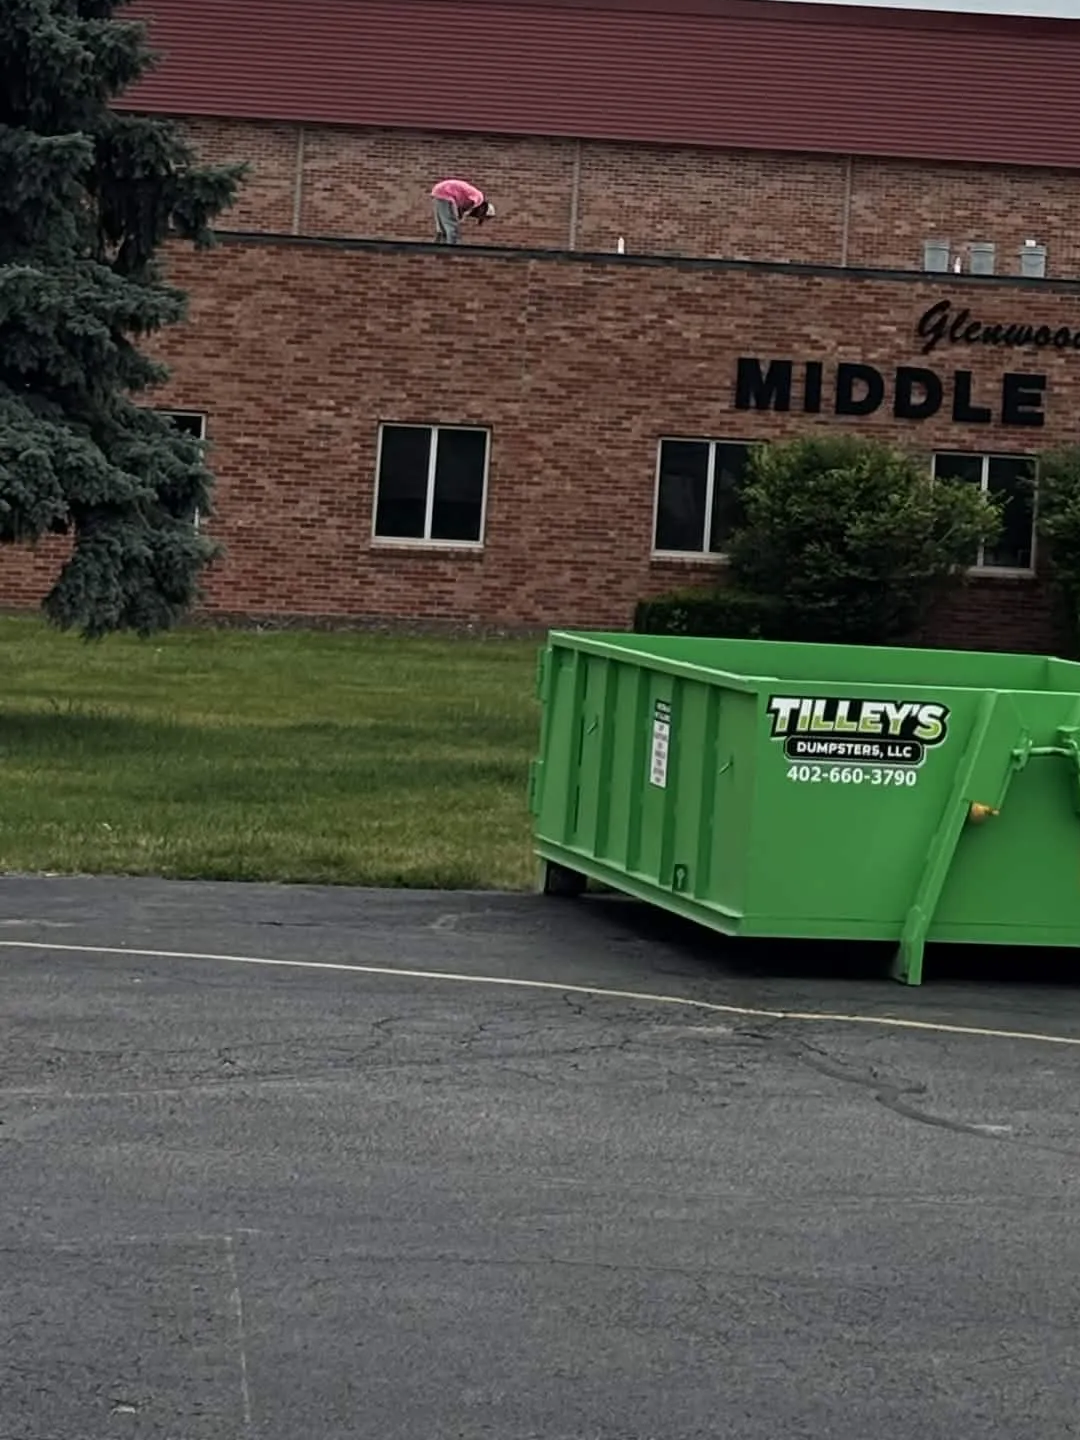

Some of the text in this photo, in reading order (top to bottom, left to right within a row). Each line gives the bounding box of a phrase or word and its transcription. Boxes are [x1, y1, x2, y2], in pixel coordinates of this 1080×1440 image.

[734, 358, 1047, 426] MIDDLE
[770, 697, 945, 741] TILLEY'S
[796, 741, 912, 759] DUMPSTERS, LLC
[786, 765, 918, 787] 402-660-3790
